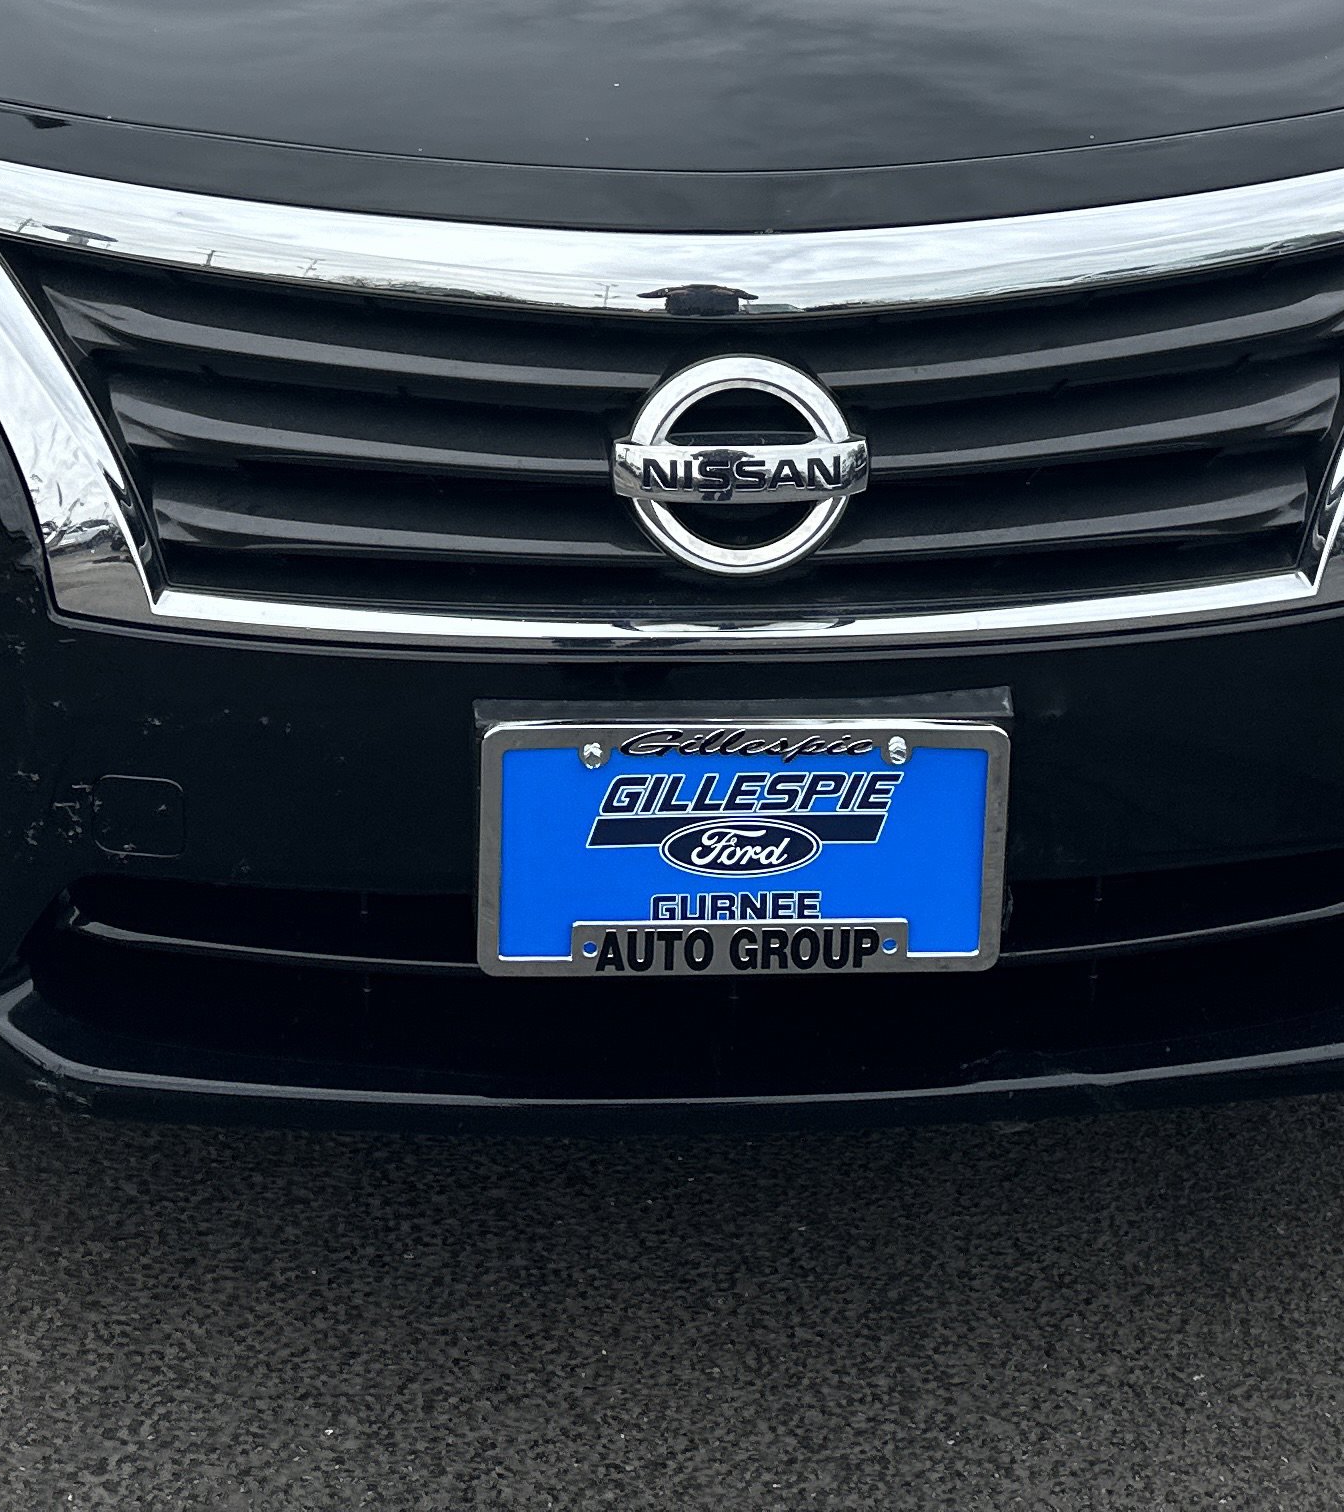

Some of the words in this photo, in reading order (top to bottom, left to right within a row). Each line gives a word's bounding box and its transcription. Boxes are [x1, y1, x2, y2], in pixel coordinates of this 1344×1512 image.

[641, 455, 842, 491] NISSAN
[620, 729, 873, 763] Gillespie
[600, 772, 904, 815] GILLESPIE
[690, 828, 791, 866] Ford
[650, 890, 822, 921] GURNEE
[595, 928, 714, 972] AUTO
[729, 926, 881, 970] GROUP
